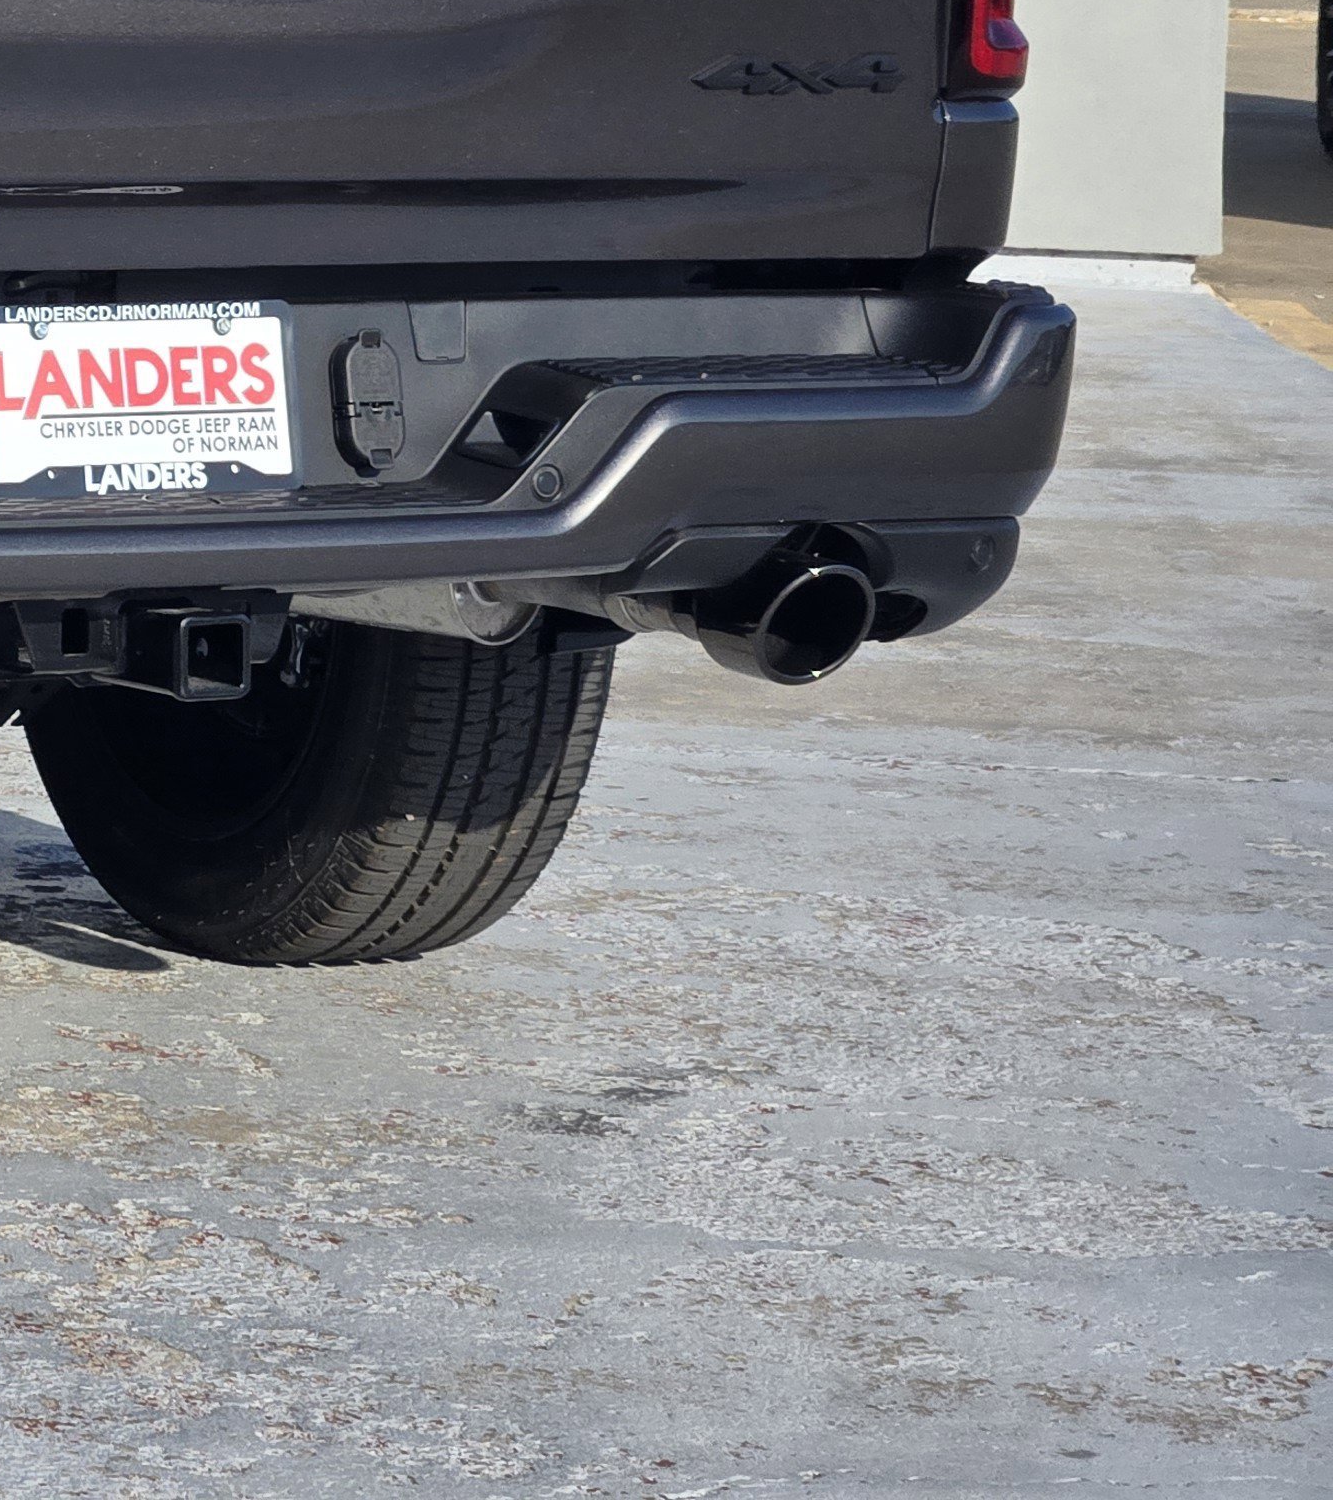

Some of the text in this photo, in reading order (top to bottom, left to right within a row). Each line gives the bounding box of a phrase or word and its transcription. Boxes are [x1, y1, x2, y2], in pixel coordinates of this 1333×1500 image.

[5, 302, 261, 323] LANDERSCDJRNORMAN.COM
[39, 416, 277, 439] CHRYSLER DODGE JEEP RAM
[173, 435, 279, 453] OF NORMAN
[84, 461, 209, 496] LANDERS
